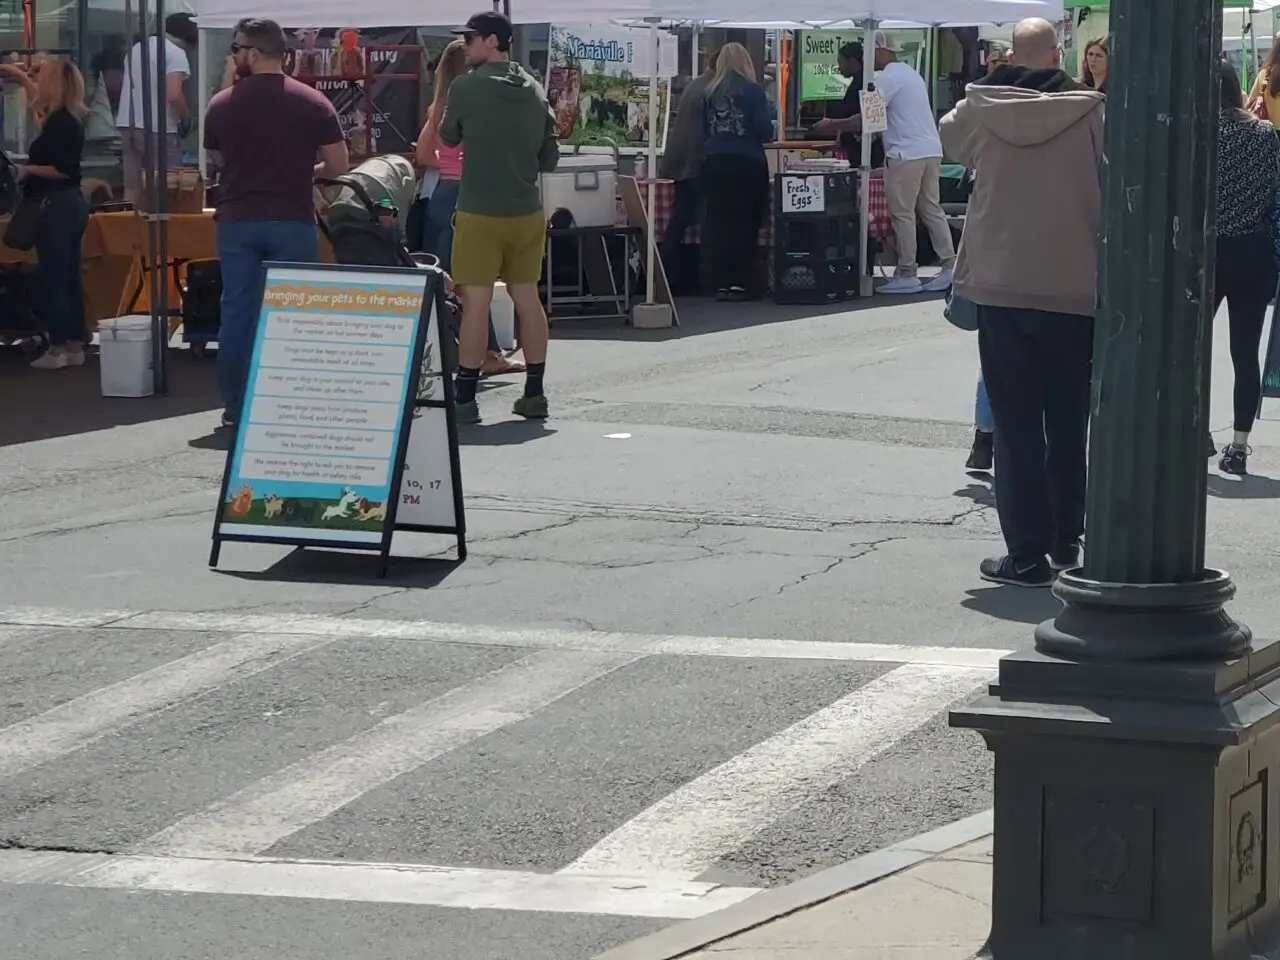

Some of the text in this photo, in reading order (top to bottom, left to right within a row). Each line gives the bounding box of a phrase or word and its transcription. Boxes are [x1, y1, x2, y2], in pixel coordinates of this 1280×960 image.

[567, 37, 624, 62] Mariaville
[806, 35, 834, 54] Sweet
[787, 181, 809, 194] Fresh
[791, 194, 812, 210] Eggs
[264, 290, 305, 306] Bringing
[306, 294, 328, 305] your
[331, 294, 353, 307] pets
[356, 294, 367, 305] to
[370, 294, 385, 306] the
[430, 480, 442, 490] 17
[402, 494, 421, 505] PM
